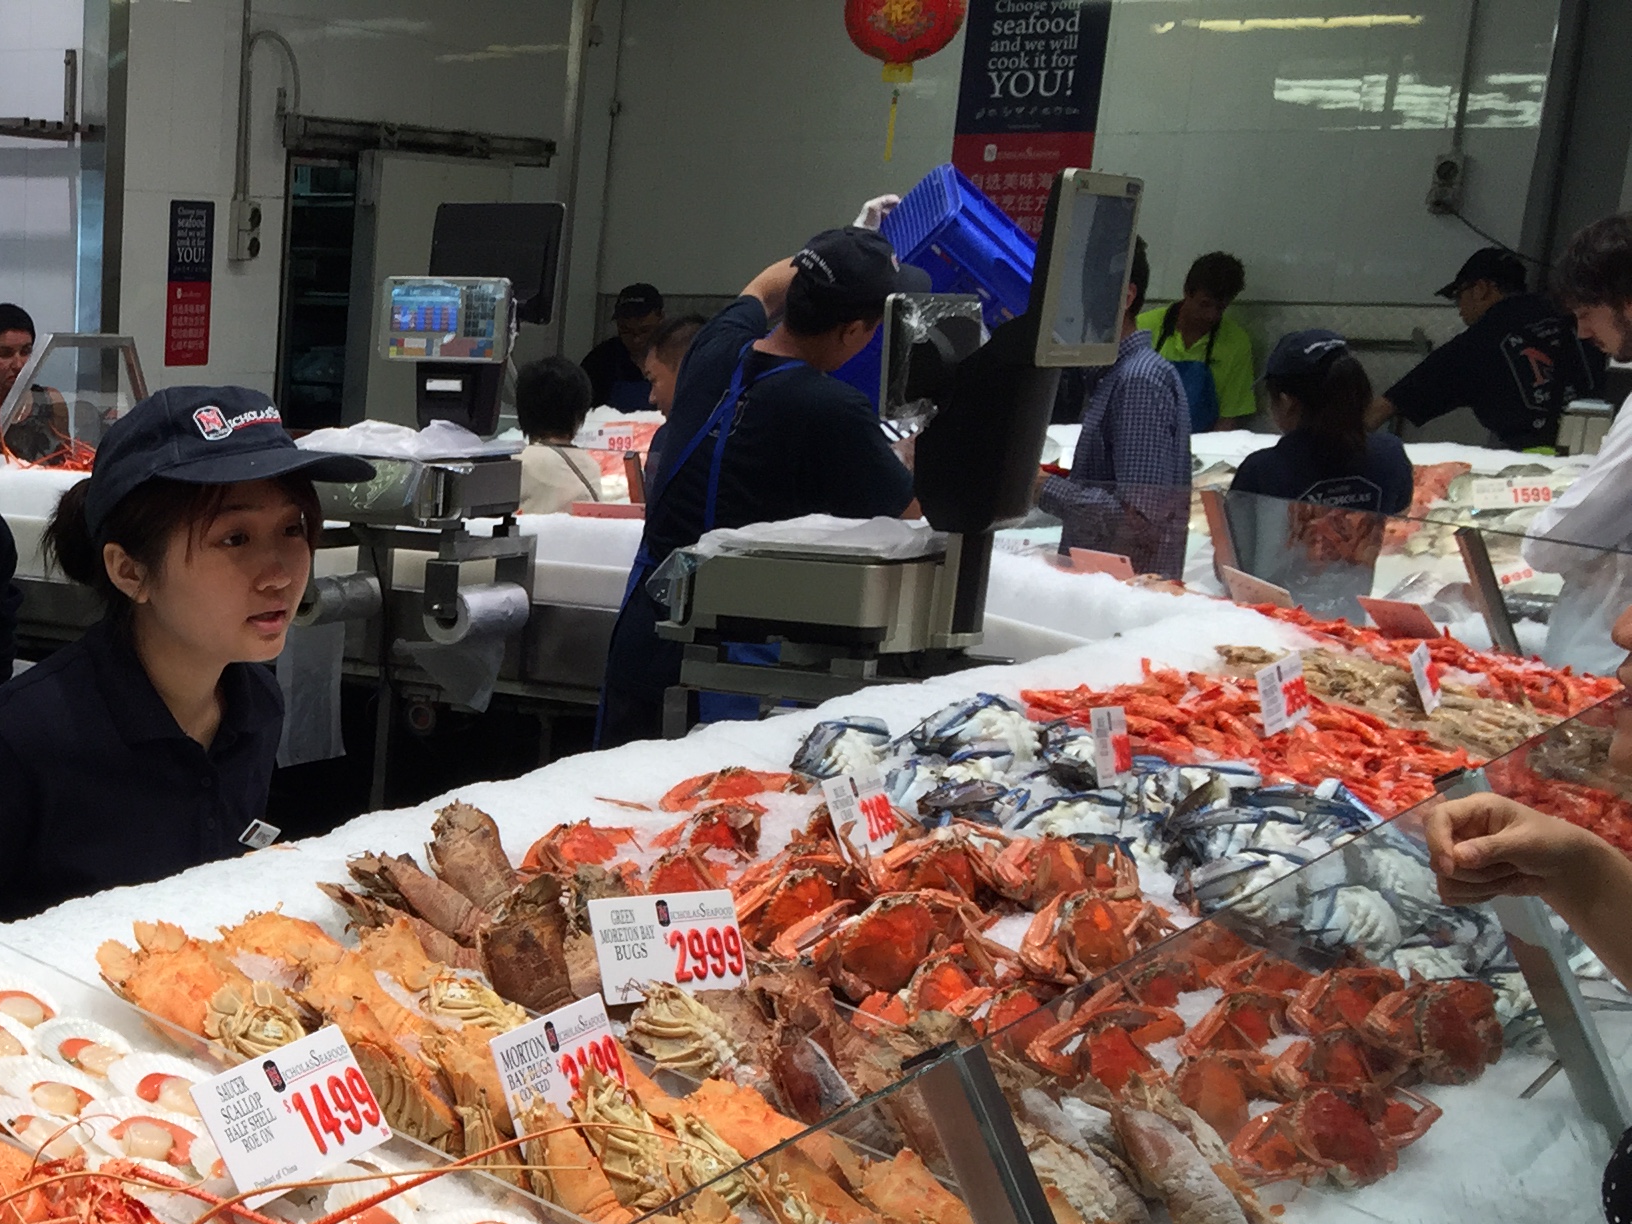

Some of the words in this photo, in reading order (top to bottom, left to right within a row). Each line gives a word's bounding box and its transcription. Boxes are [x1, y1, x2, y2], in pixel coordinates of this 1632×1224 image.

[995, 0, 1048, 13] Choose
[1051, 1, 1081, 15] your
[992, 11, 1081, 36] seafood
[990, 36, 1021, 52] and
[1024, 40, 1046, 50] we
[1049, 34, 1079, 50] will
[988, 52, 1030, 69] cook
[1034, 52, 1047, 68] it
[1051, 50, 1078, 67] for
[988, 69, 1075, 98] YOU!
[177, 247, 206, 263] YOU!
[610, 909, 636, 925] GREEN
[599, 926, 639, 944] MORETON
[640, 925, 656, 940] BAY
[614, 942, 648, 961] BUGS
[500, 1034, 547, 1072] MORTON
[215, 1075, 250, 1103] SAUCER
[220, 1091, 266, 1125] SCALLOP
[224, 1118, 253, 1144] HALF
[251, 1107, 278, 1132] SHELL
[241, 1134, 266, 1153] ROE
[264, 1126, 276, 1142] ON
